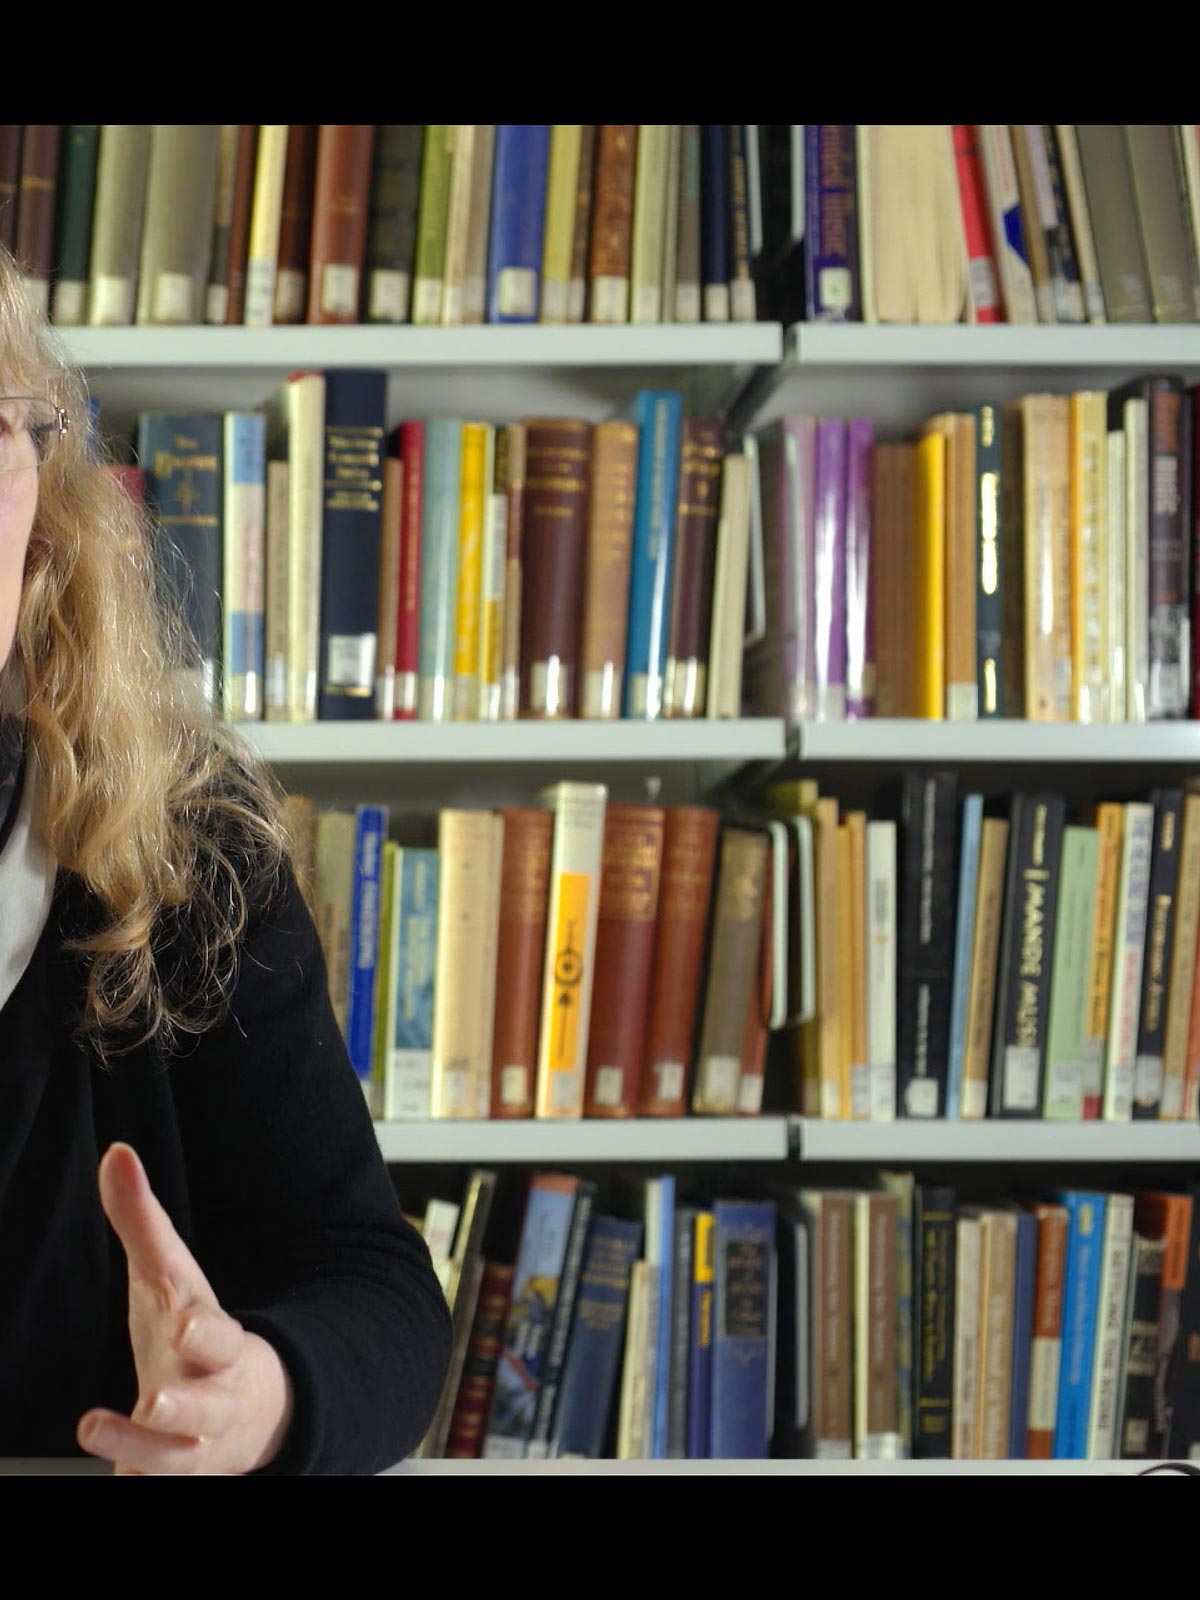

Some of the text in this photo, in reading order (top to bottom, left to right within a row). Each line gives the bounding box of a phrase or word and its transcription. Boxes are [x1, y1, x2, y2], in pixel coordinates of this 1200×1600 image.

[1019, 882, 1046, 977] MANDE
[1097, 1249, 1125, 1432] SETTLING THE SCORE
